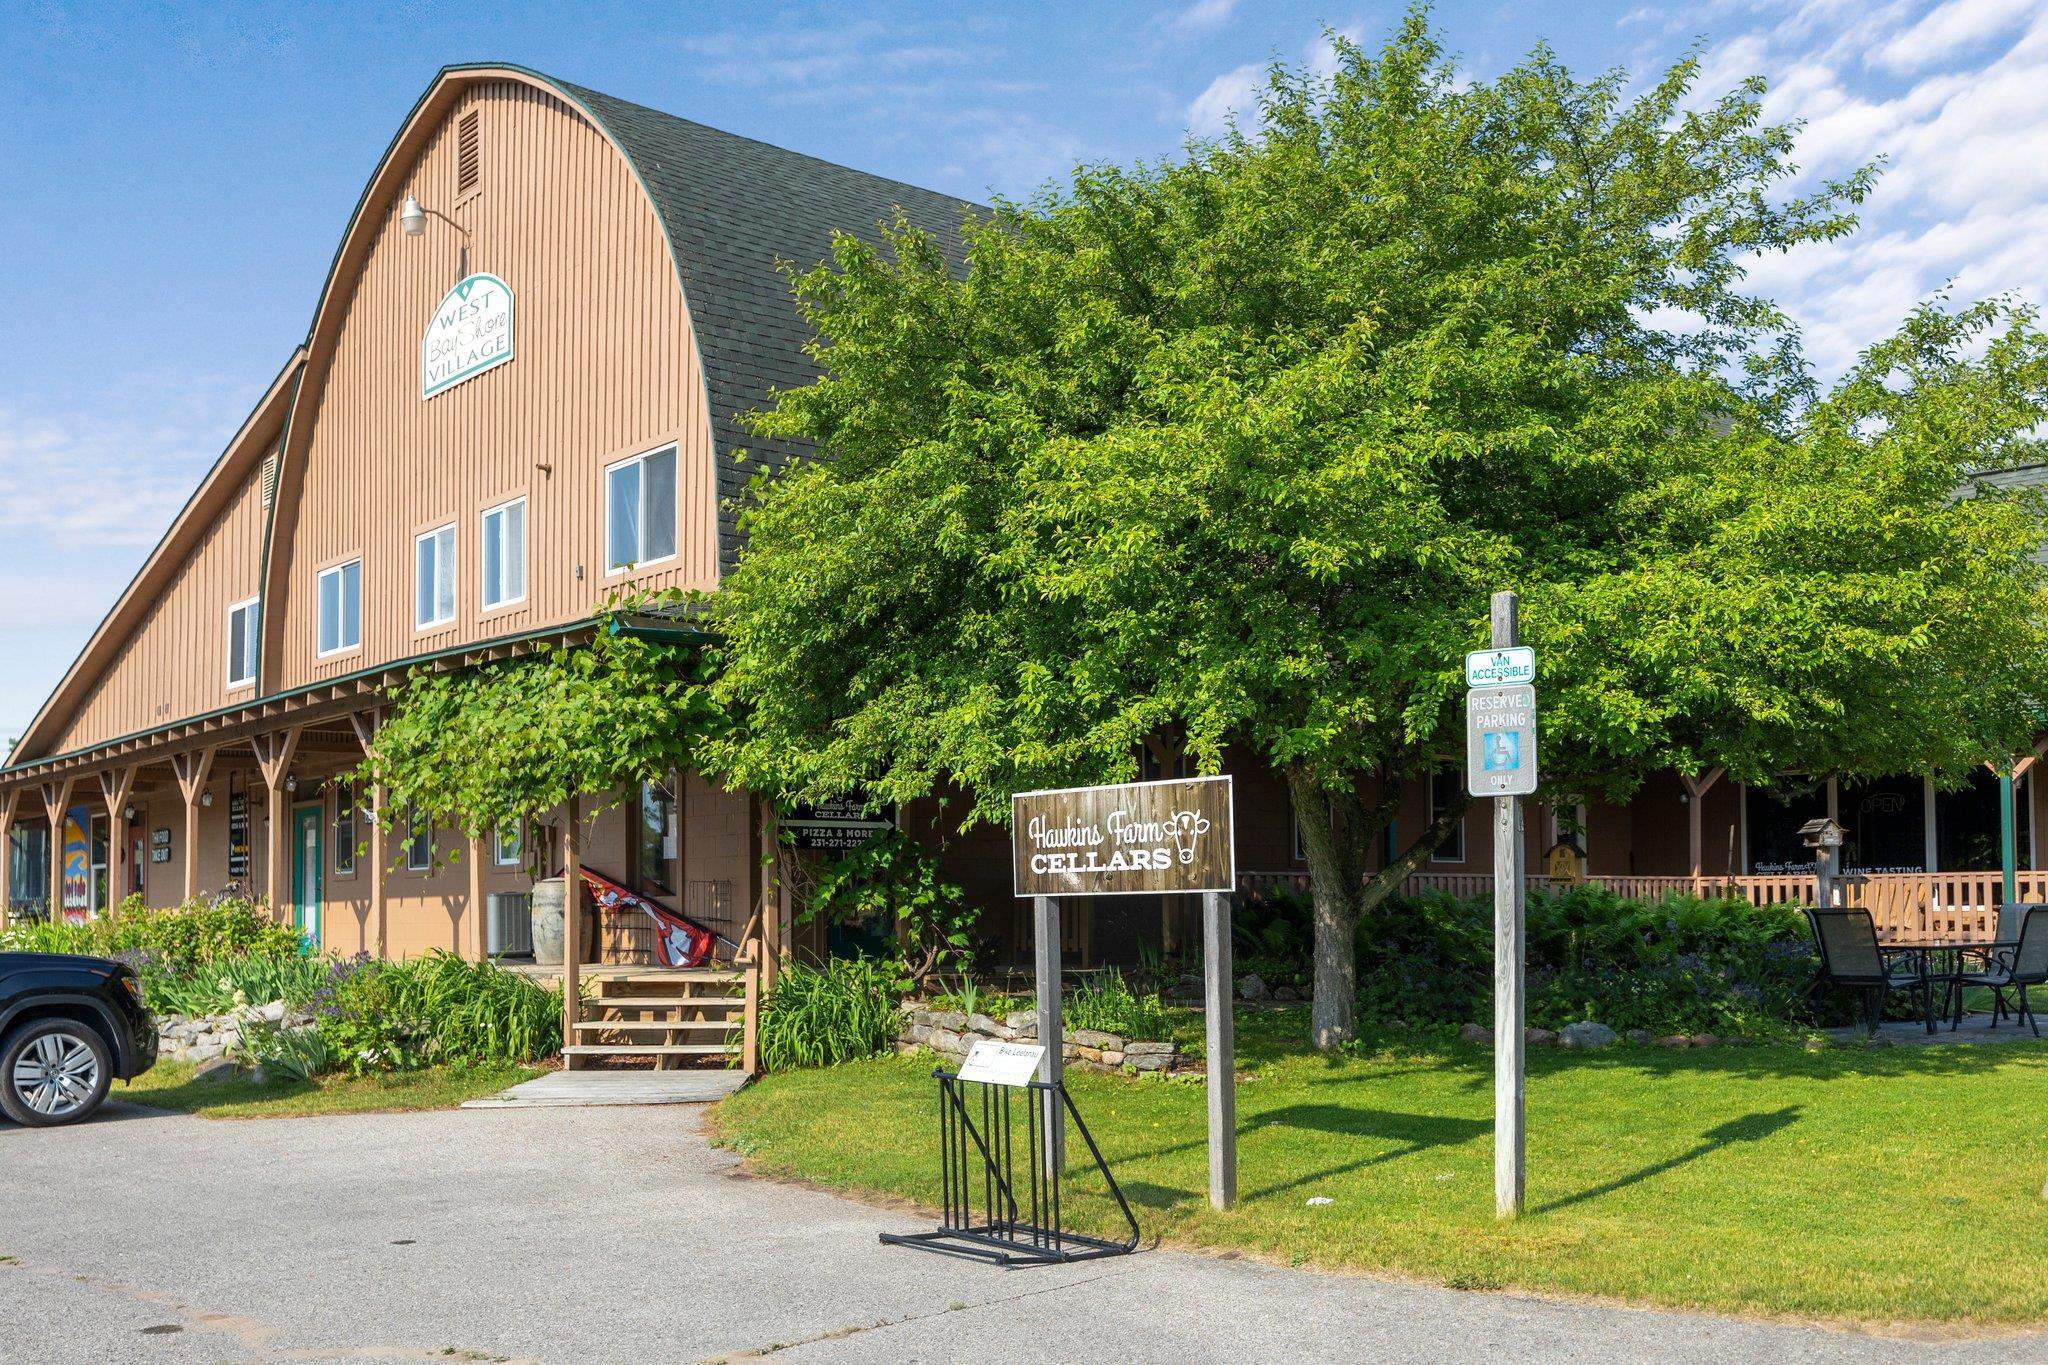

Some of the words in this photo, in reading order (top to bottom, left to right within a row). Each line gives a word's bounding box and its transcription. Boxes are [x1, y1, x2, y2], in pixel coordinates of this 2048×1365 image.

[440, 290, 495, 330] WEST
[428, 334, 505, 382] VILLAGE
[1490, 656, 1510, 667] VAN
[1472, 665, 1530, 680] ACCESSIBLE
[1471, 693, 1531, 711] RESERVED
[1476, 712, 1526, 729] PARKING
[1490, 774, 1514, 786] ONLY
[814, 811, 867, 820] CELLAR
[802, 828, 833, 837] PIZZA
[836, 829, 843, 837] &
[846, 829, 873, 838] MORE
[1028, 814, 1104, 849] Hawkins
[1107, 810, 1164, 846] Farm
[811, 838, 866, 847] 231-271-222
[1030, 848, 1173, 875] CELLARS
[1842, 867, 1872, 875] WINE
[1875, 866, 1923, 875] TASTING
